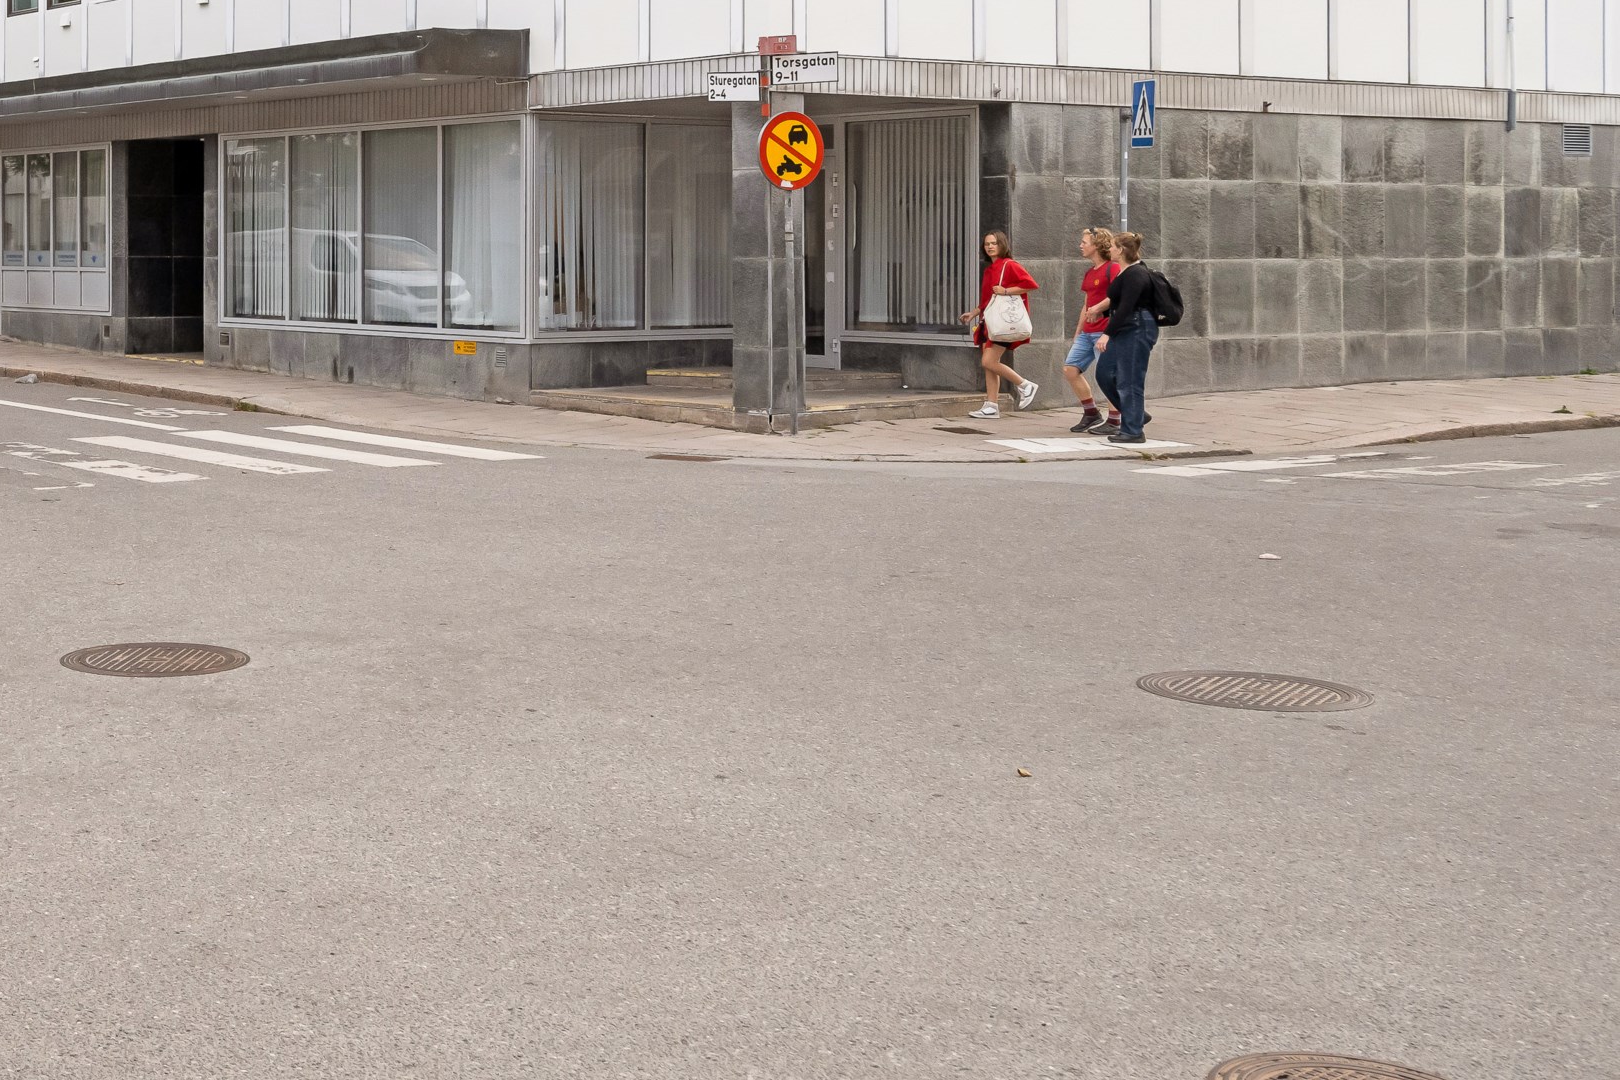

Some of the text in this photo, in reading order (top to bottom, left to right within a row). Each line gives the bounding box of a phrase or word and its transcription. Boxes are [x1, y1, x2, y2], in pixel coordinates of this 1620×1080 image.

[775, 56, 835, 69] Torsgatan
[709, 75, 757, 87] Sturegatan
[775, 71, 798, 82] 9-11
[710, 89, 726, 99] 2-4
